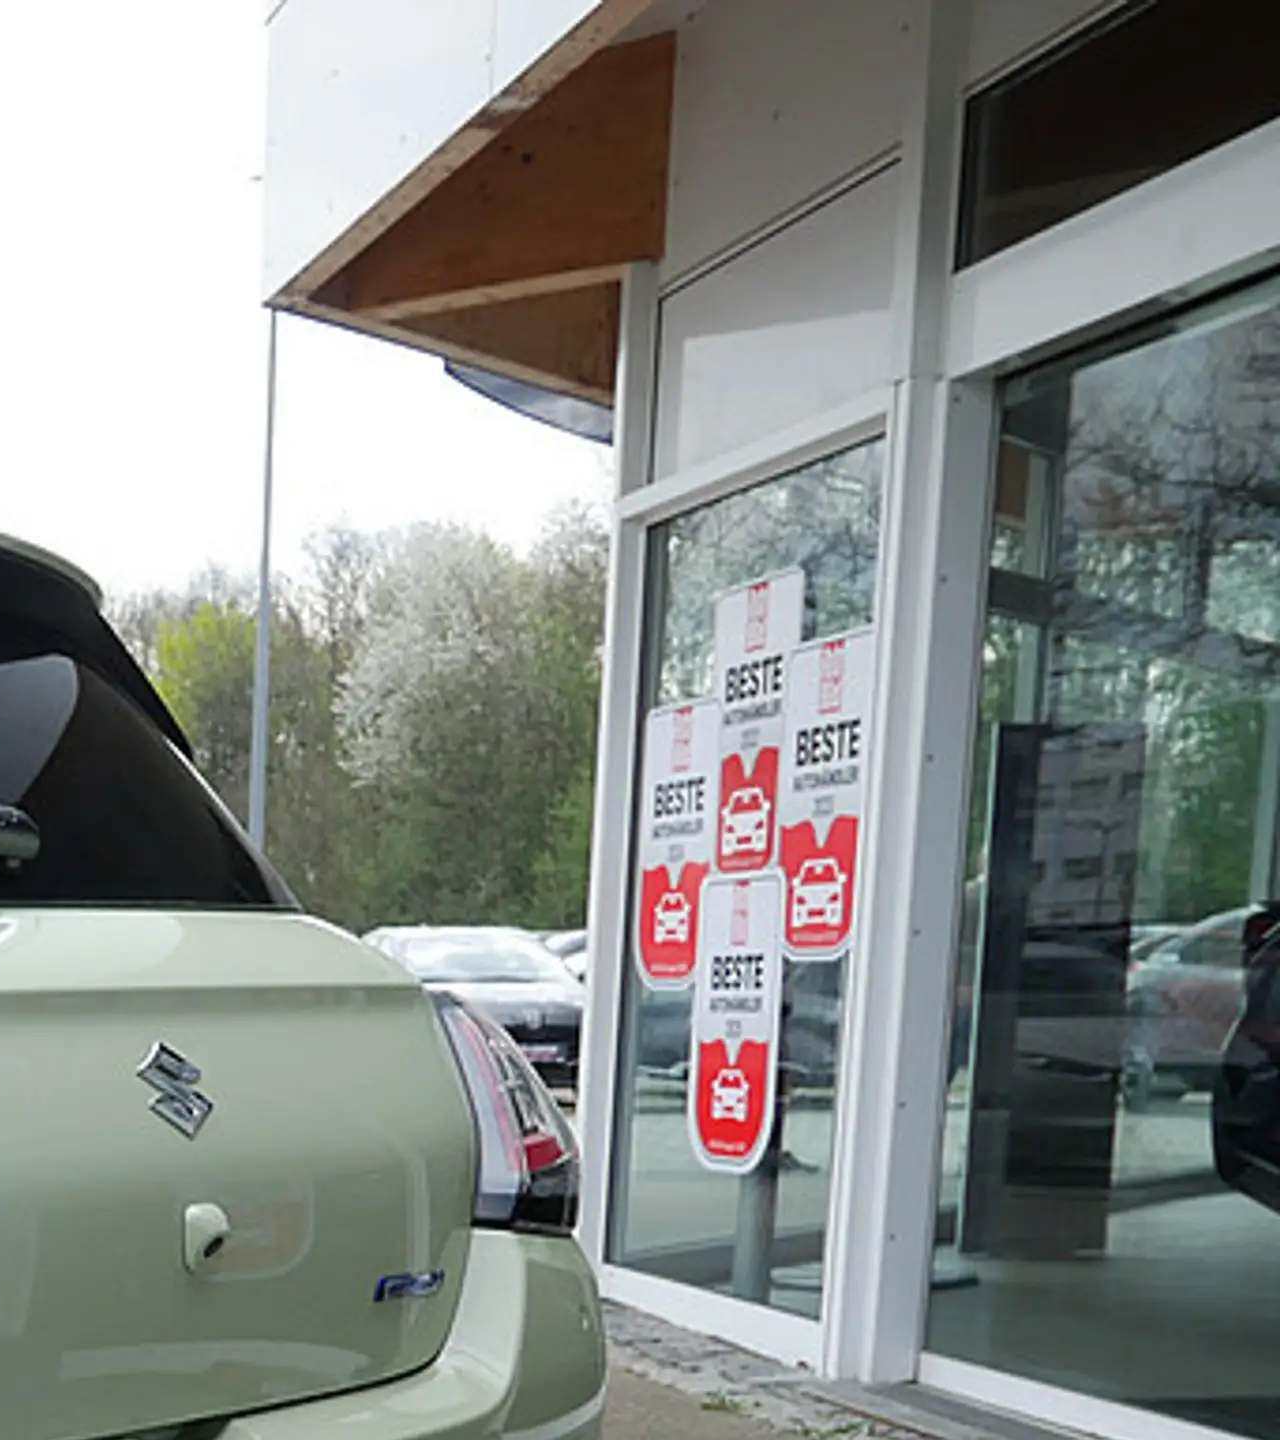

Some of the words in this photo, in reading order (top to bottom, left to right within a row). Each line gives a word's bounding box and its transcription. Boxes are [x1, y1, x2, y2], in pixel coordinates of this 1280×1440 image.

[724, 654, 783, 702] BESTE
[796, 717, 861, 766] BESTE
[653, 776, 705, 818] BESTE
[710, 953, 764, 990] BESTE
